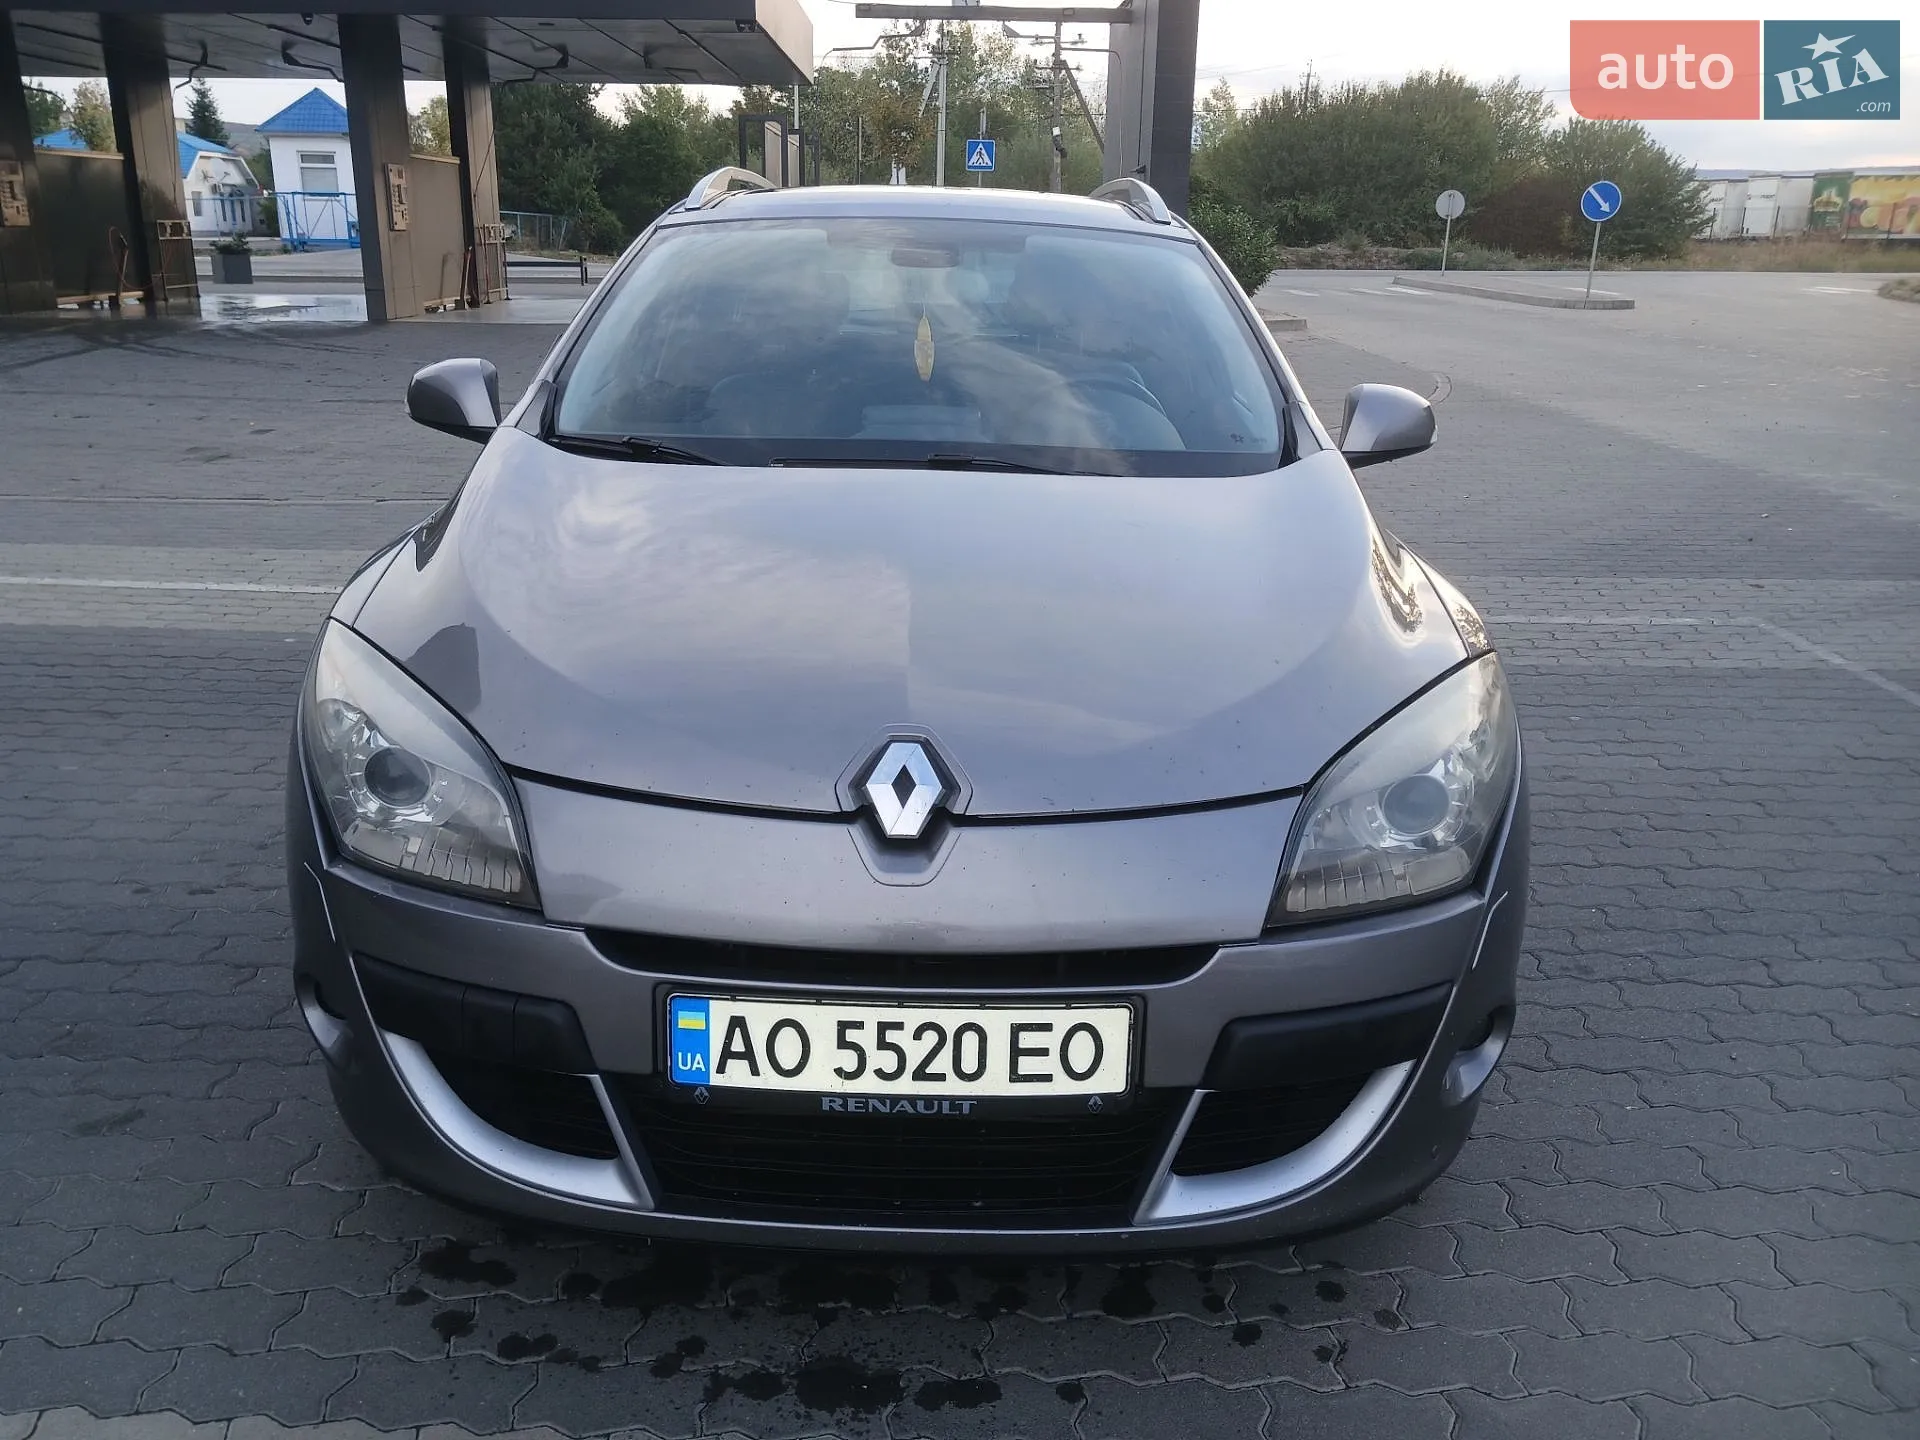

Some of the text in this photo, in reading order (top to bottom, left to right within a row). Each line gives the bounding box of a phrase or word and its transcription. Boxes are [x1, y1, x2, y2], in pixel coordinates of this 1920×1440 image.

[715, 1015, 1104, 1084] AO 5520 EO
[678, 1051, 706, 1072] UA
[821, 1096, 978, 1115] RENAULT
